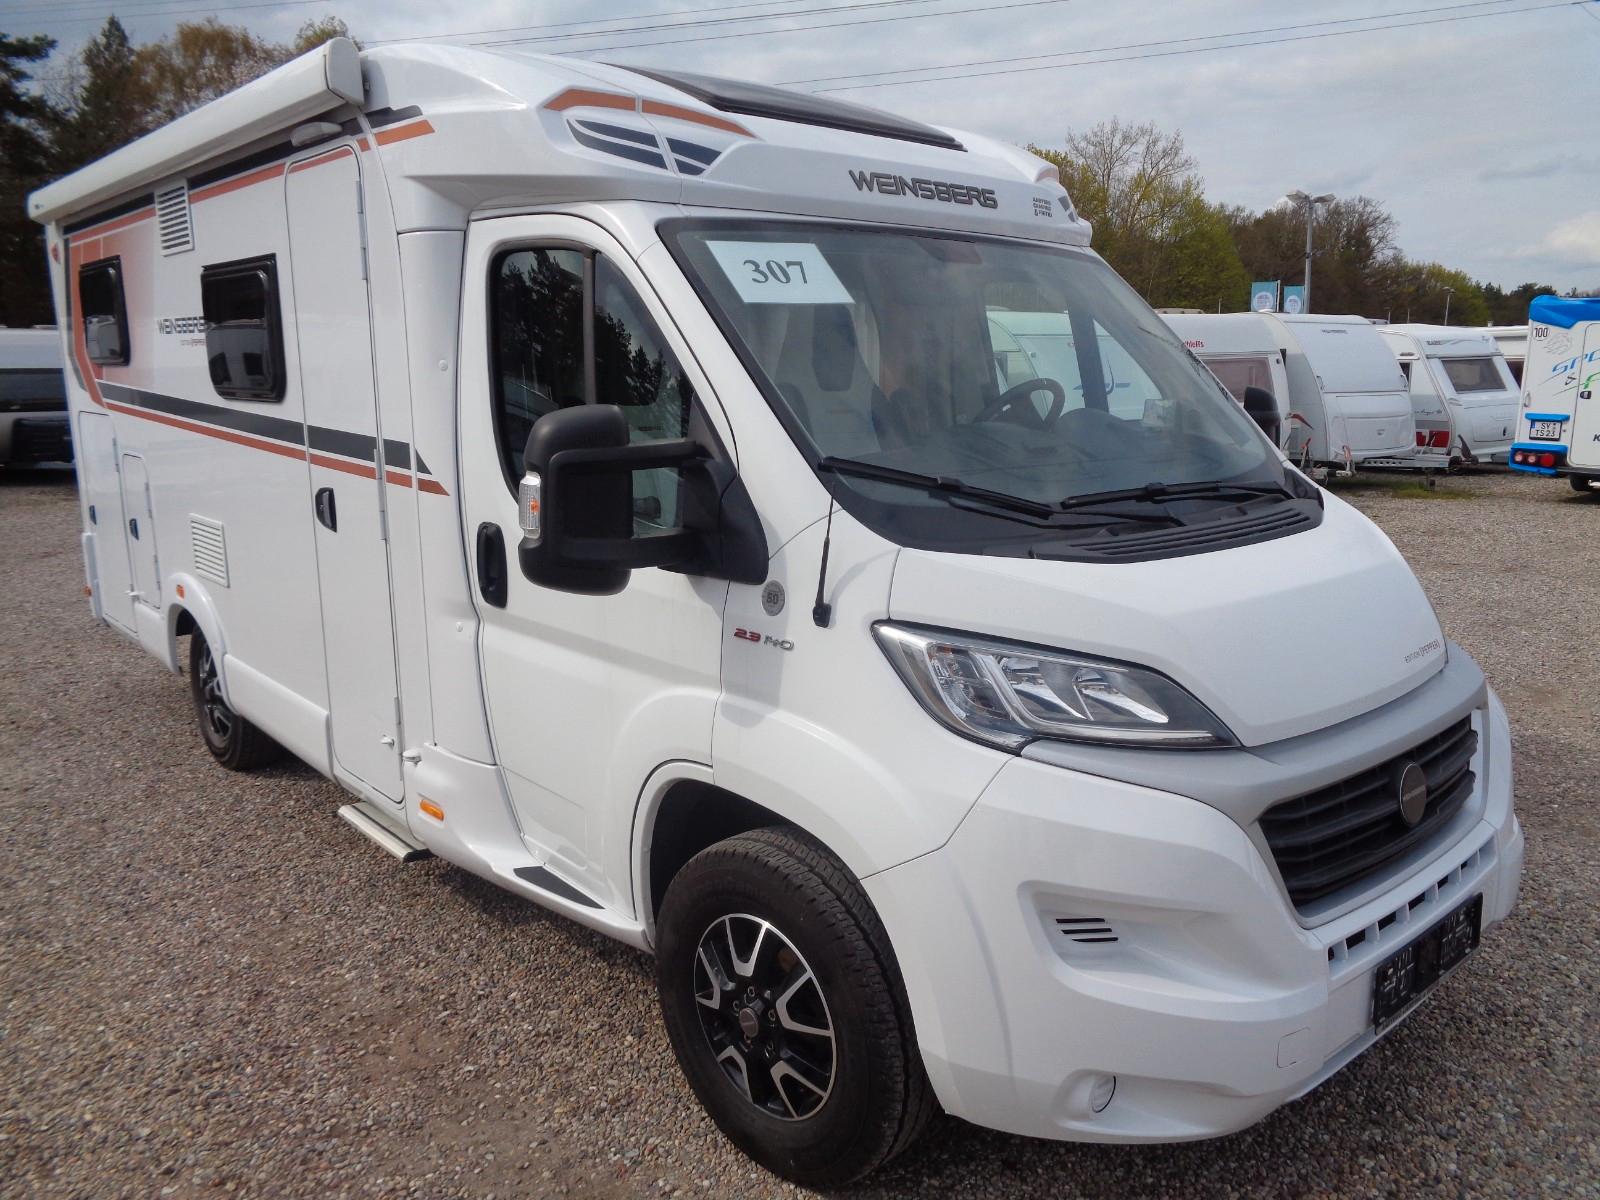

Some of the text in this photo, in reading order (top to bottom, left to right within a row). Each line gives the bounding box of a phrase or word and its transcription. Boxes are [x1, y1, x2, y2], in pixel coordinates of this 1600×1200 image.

[848, 169, 999, 210] WEINSBERG
[743, 259, 808, 285] 307
[1534, 327, 1549, 338] 100
